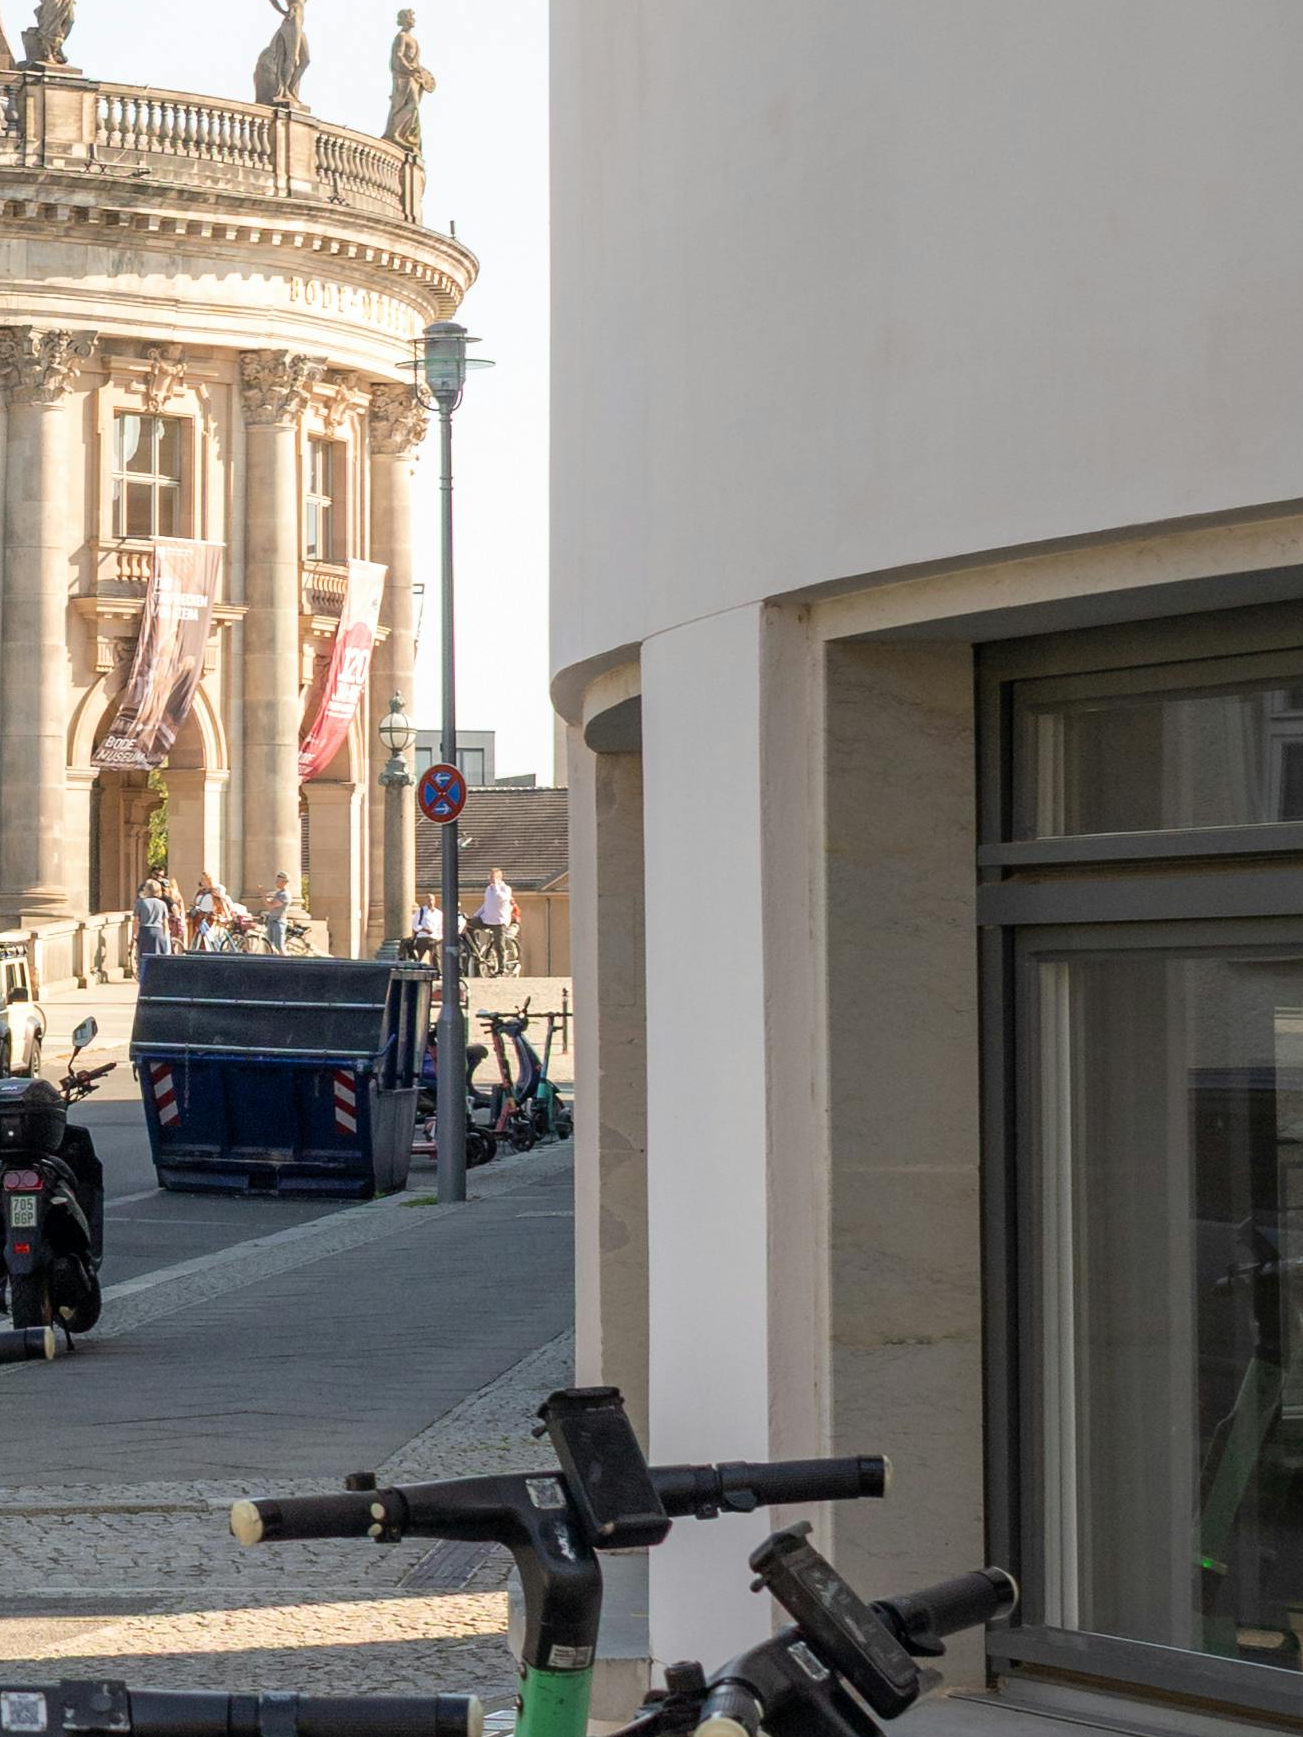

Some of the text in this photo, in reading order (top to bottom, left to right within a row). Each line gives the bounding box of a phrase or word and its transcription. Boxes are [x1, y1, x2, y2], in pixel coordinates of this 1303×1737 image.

[339, 647, 370, 684] 120
[105, 735, 137, 750] BODE
[13, 1198, 33, 1211] 705
